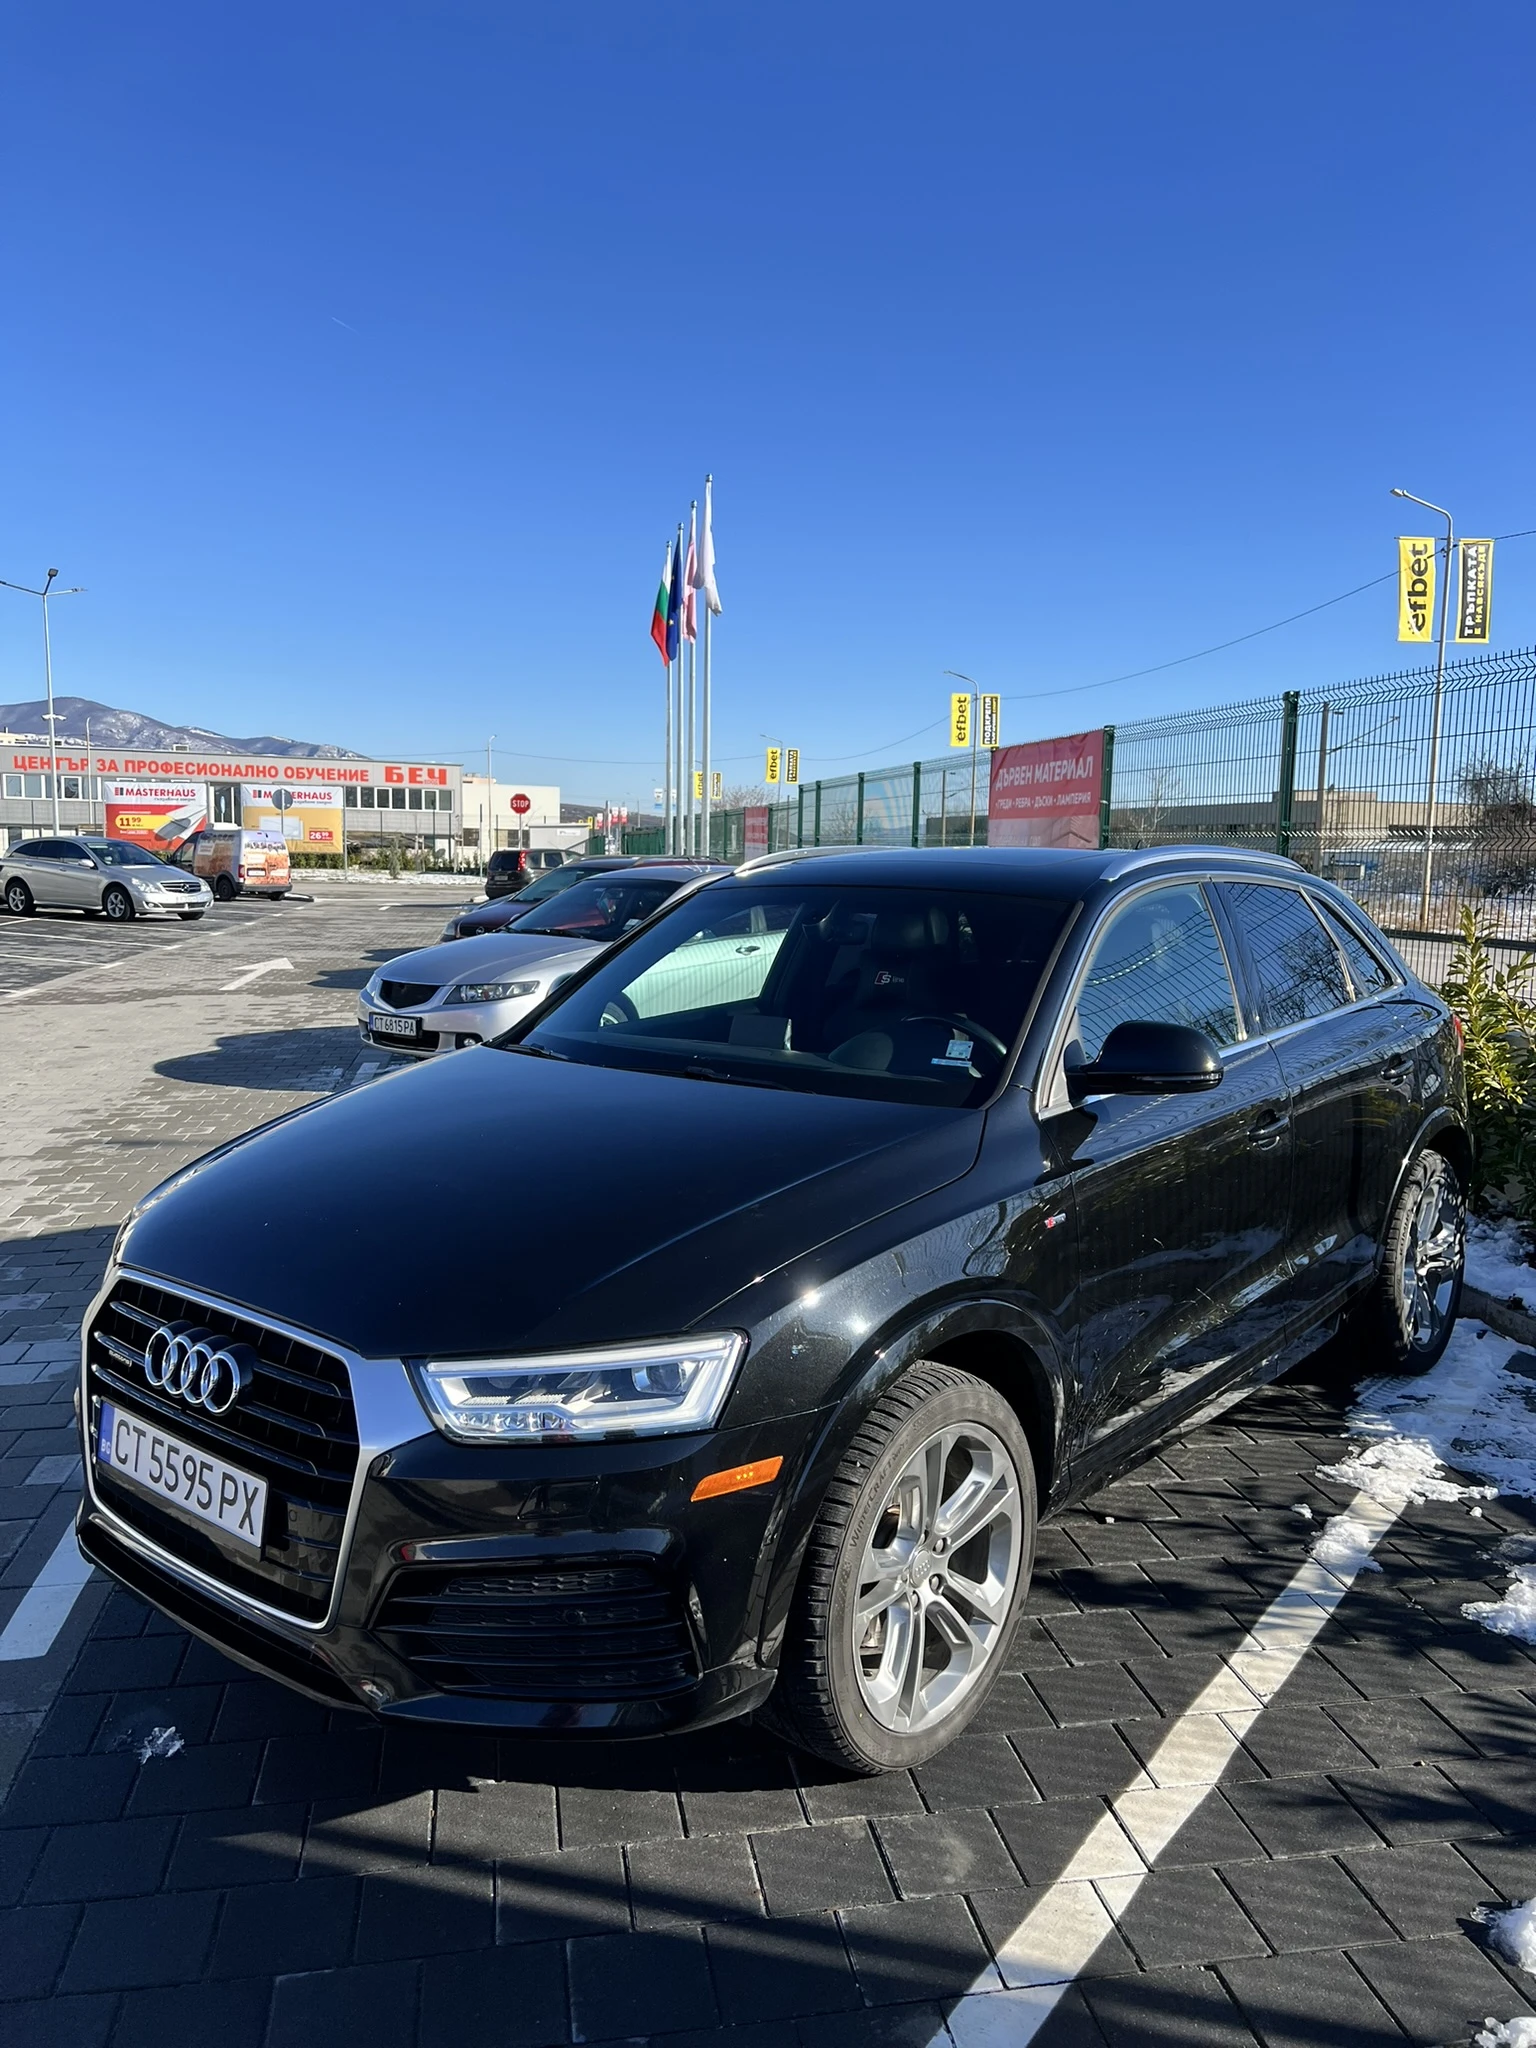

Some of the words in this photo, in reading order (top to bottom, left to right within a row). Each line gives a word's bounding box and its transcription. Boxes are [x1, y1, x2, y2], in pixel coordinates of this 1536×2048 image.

[1408, 543, 1428, 632] efbet
[1463, 545, 1478, 637] ТРЪПКАТА
[1475, 545, 1487, 623] НАВСЯКЪДЕ
[1474, 627, 1482, 635] Е
[956, 696, 967, 741] efbet
[97, 759, 119, 773] ЗА
[124, 760, 279, 779] ПРОФЕСИОНАЛНО
[284, 766, 369, 782] ОБУЧЕНИЕ
[384, 766, 447, 785] БЕЧ
[769, 749, 777, 780] efbet
[996, 765, 1033, 791] ДЪРВЕН
[1034, 755, 1094, 784] МАТЕРИАЛ
[125, 788, 196, 797] MASTERHAUS
[263, 790, 333, 800] MERHAUS
[512, 800, 529, 808] STOP
[1016, 797, 1031, 808] РЕБРА
